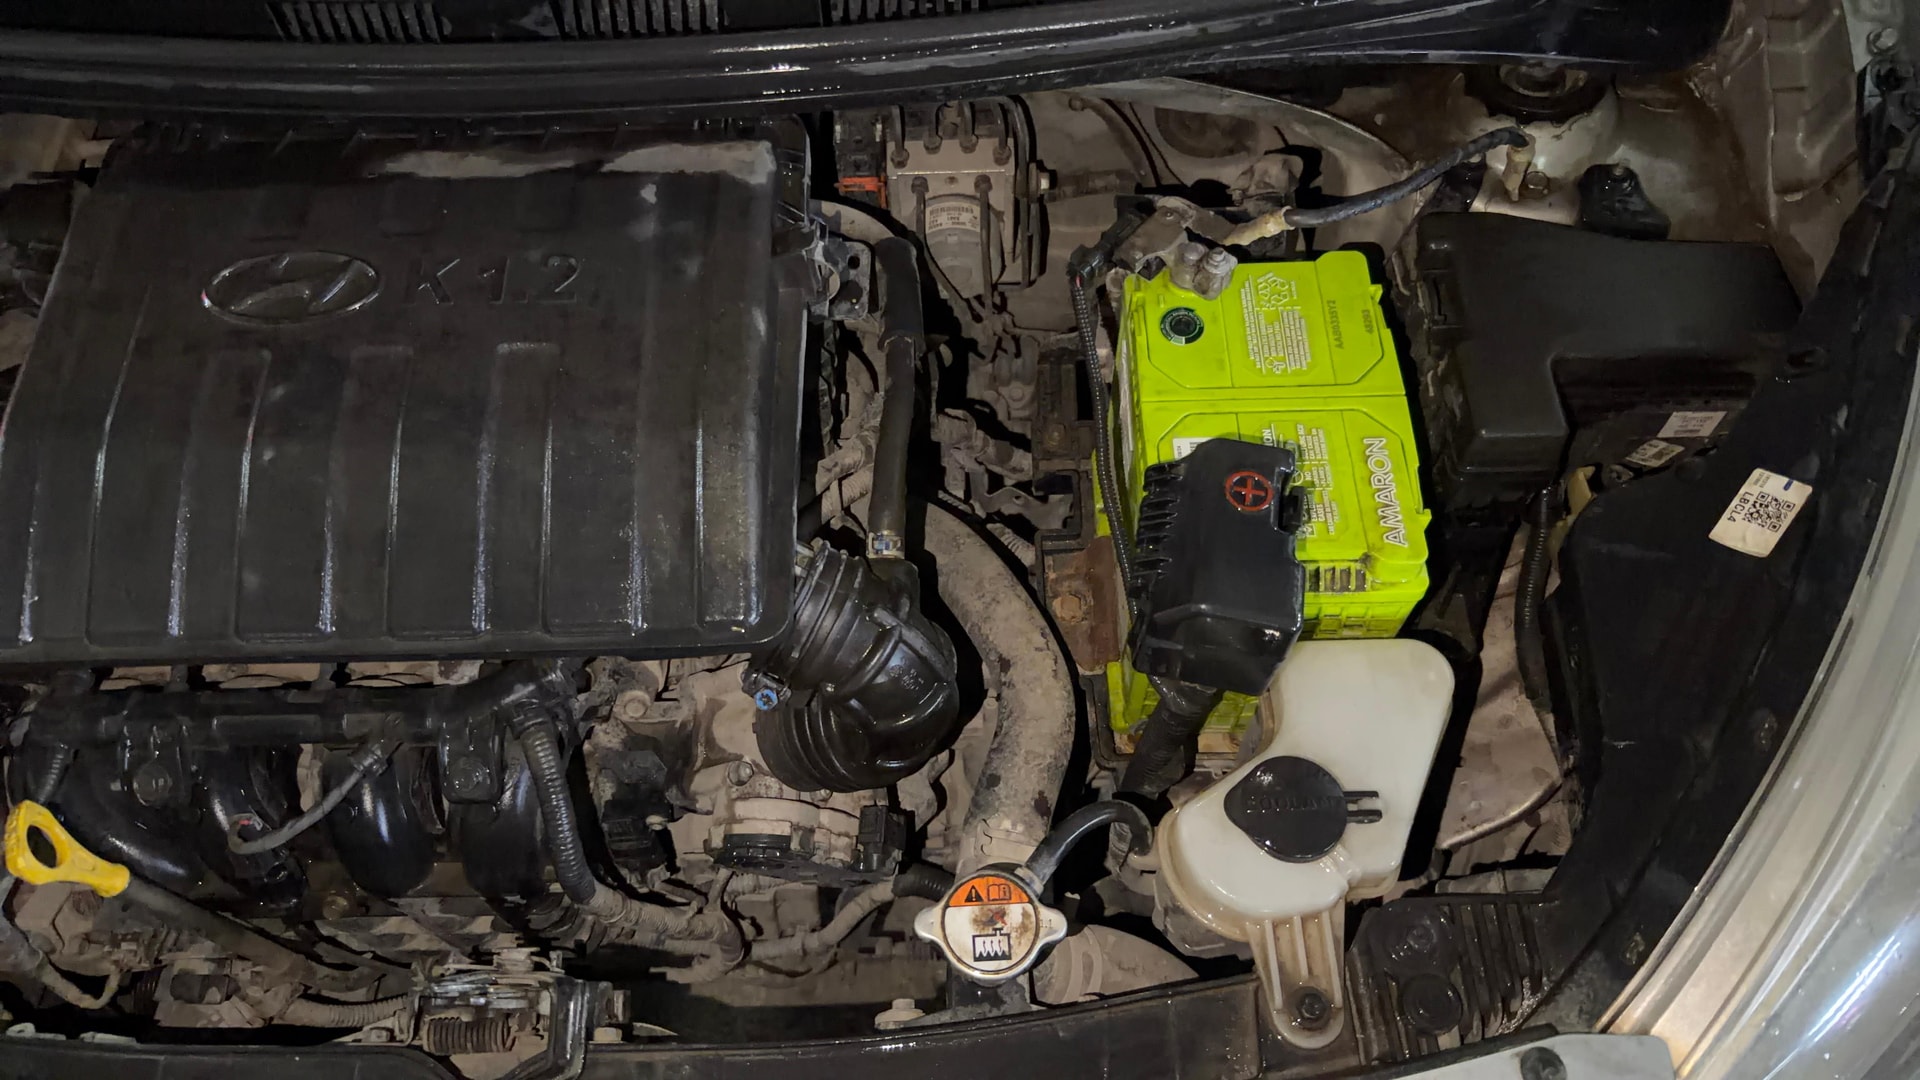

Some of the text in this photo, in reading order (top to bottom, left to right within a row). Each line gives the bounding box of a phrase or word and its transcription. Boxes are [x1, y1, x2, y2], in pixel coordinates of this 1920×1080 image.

[405, 257, 460, 304] K
[1363, 437, 1409, 548] AMARON
[1727, 491, 1754, 523] LBCL4
